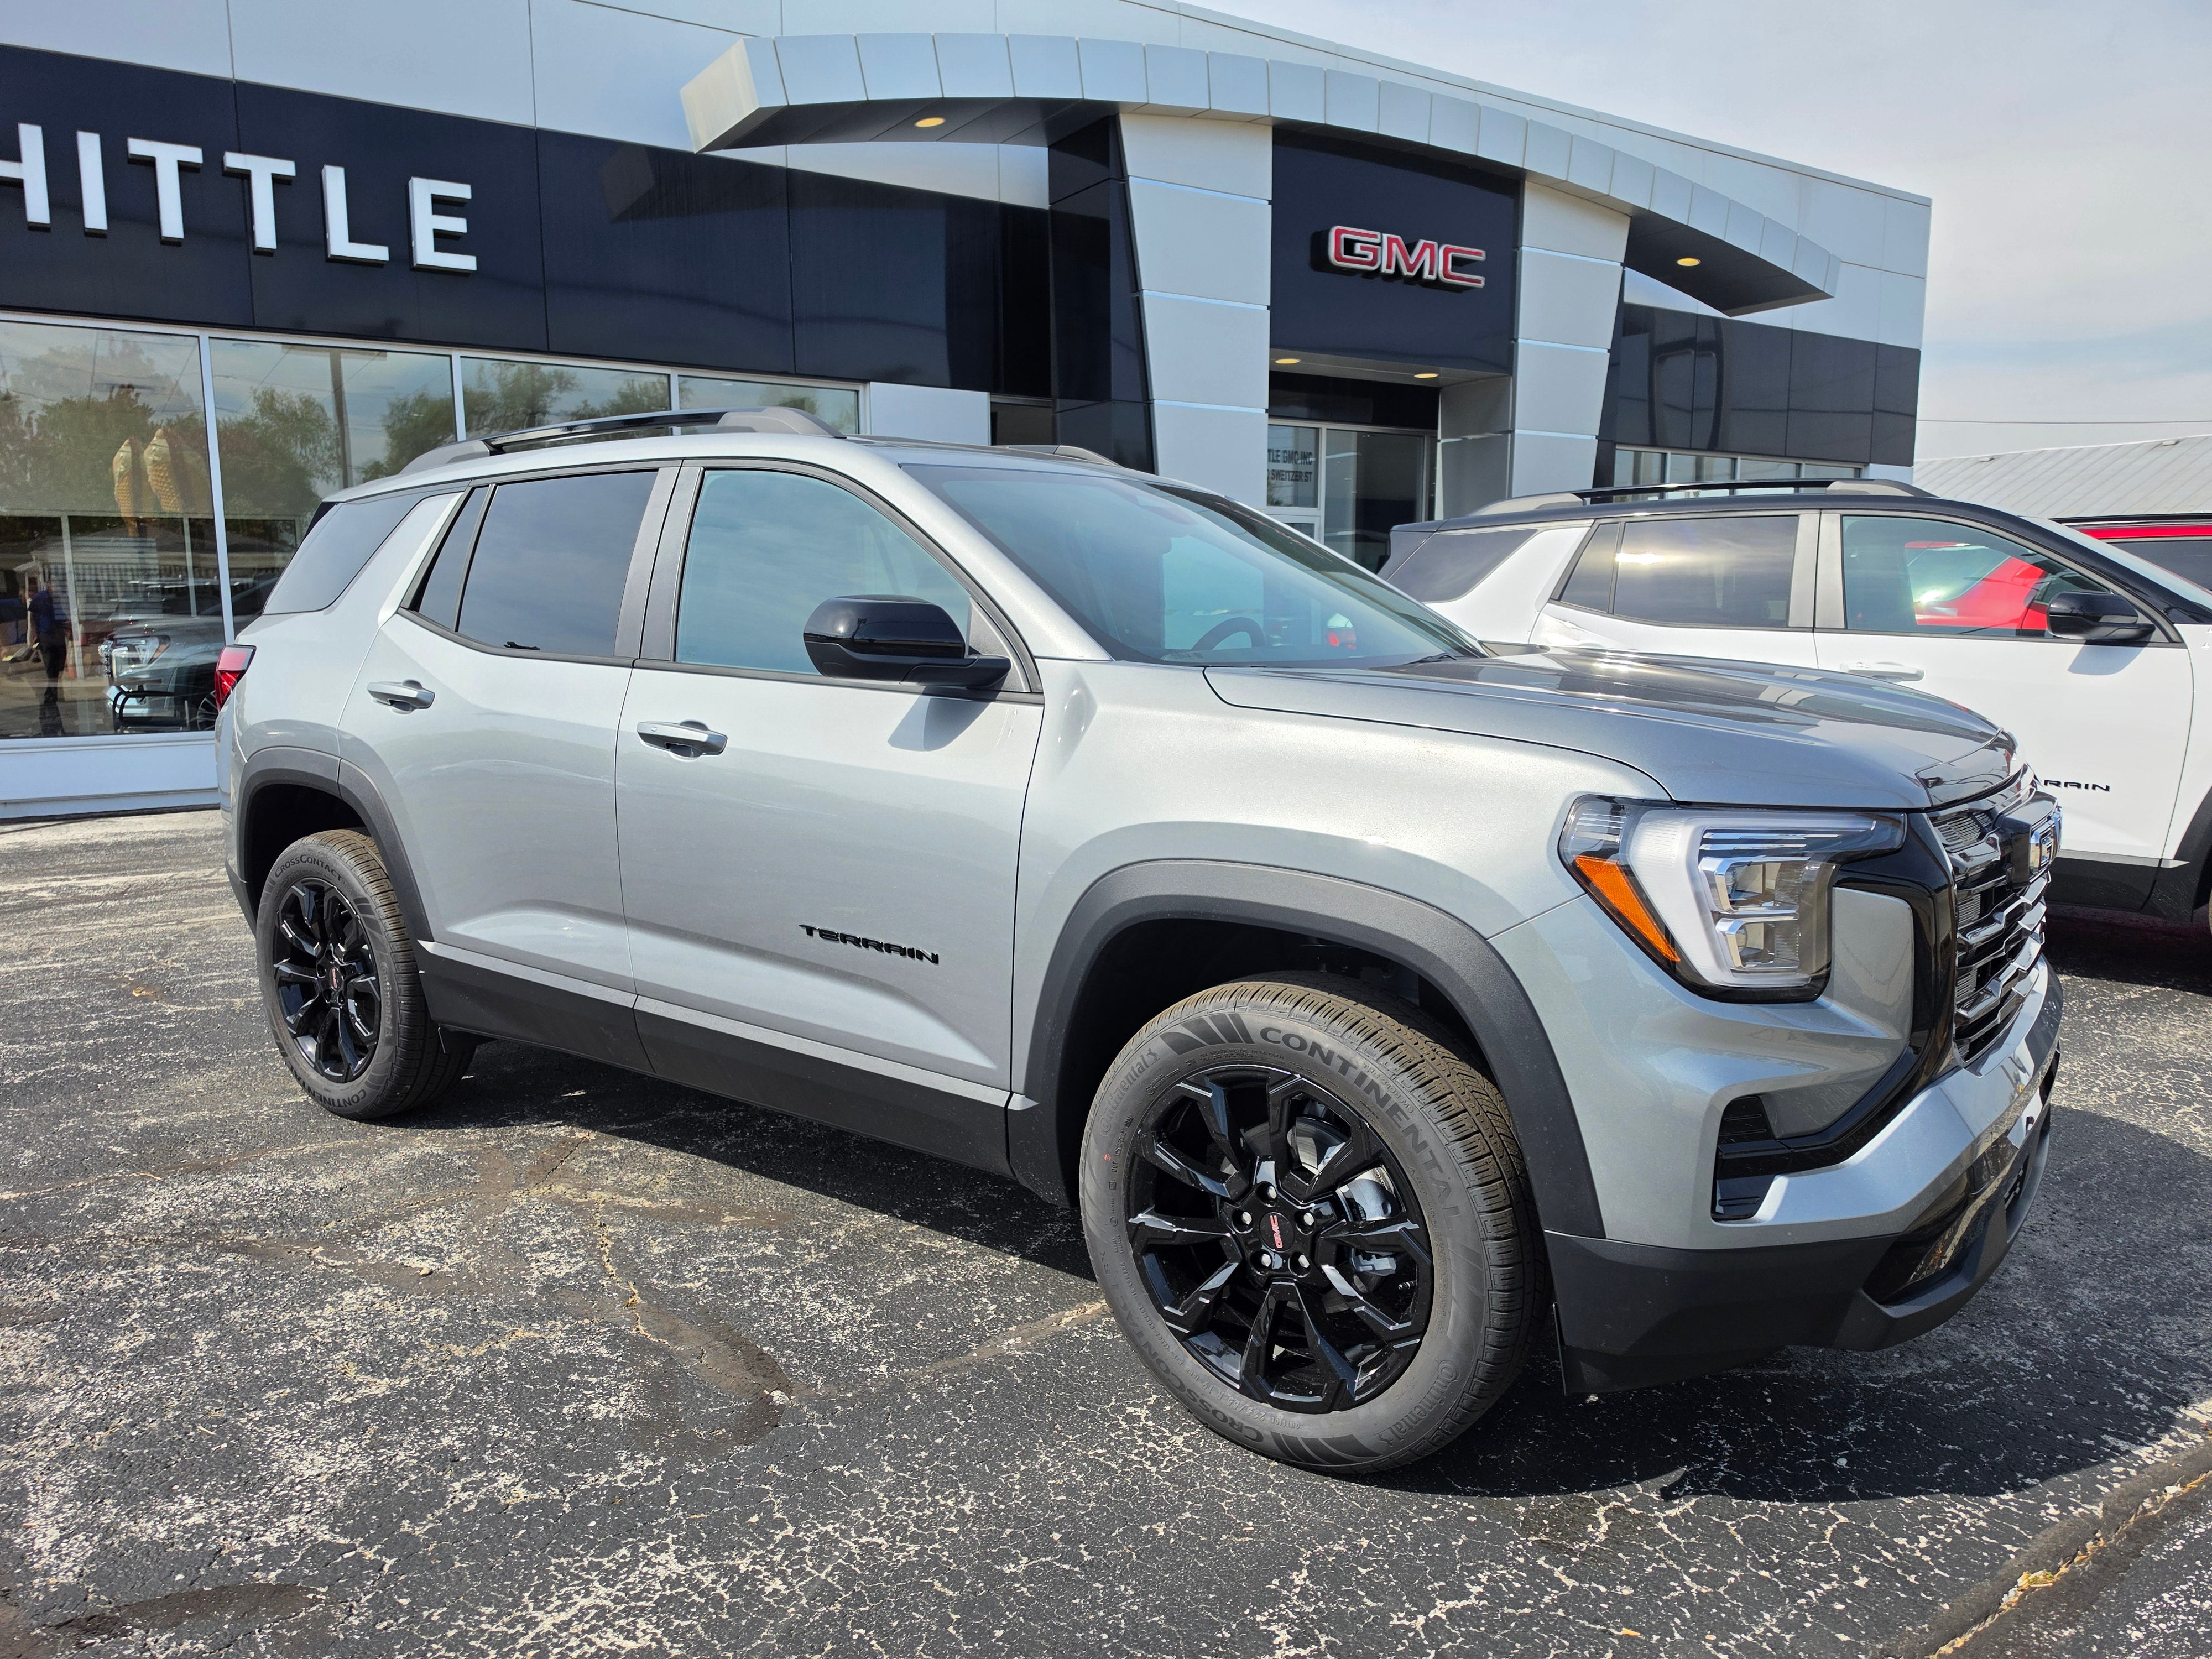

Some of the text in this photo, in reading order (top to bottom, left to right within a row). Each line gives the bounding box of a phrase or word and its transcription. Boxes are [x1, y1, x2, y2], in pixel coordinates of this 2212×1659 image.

[1329, 225, 1486, 288] GMC
[1271, 469, 1303, 482] SWEITZER
[1305, 471, 1313, 482] ST
[1282, 450, 1298, 464] GMC
[1301, 451, 1313, 465] INC
[799, 924, 939, 964] TERRAIN
[1095, 1056, 1151, 1137] Continental
[1260, 1027, 1461, 1230] CONTINENTAL
[1270, 1215, 1283, 1248] GMC
[1389, 1359, 1460, 1442] Continental
[1271, 1416, 1301, 1430] OUTSIDE
